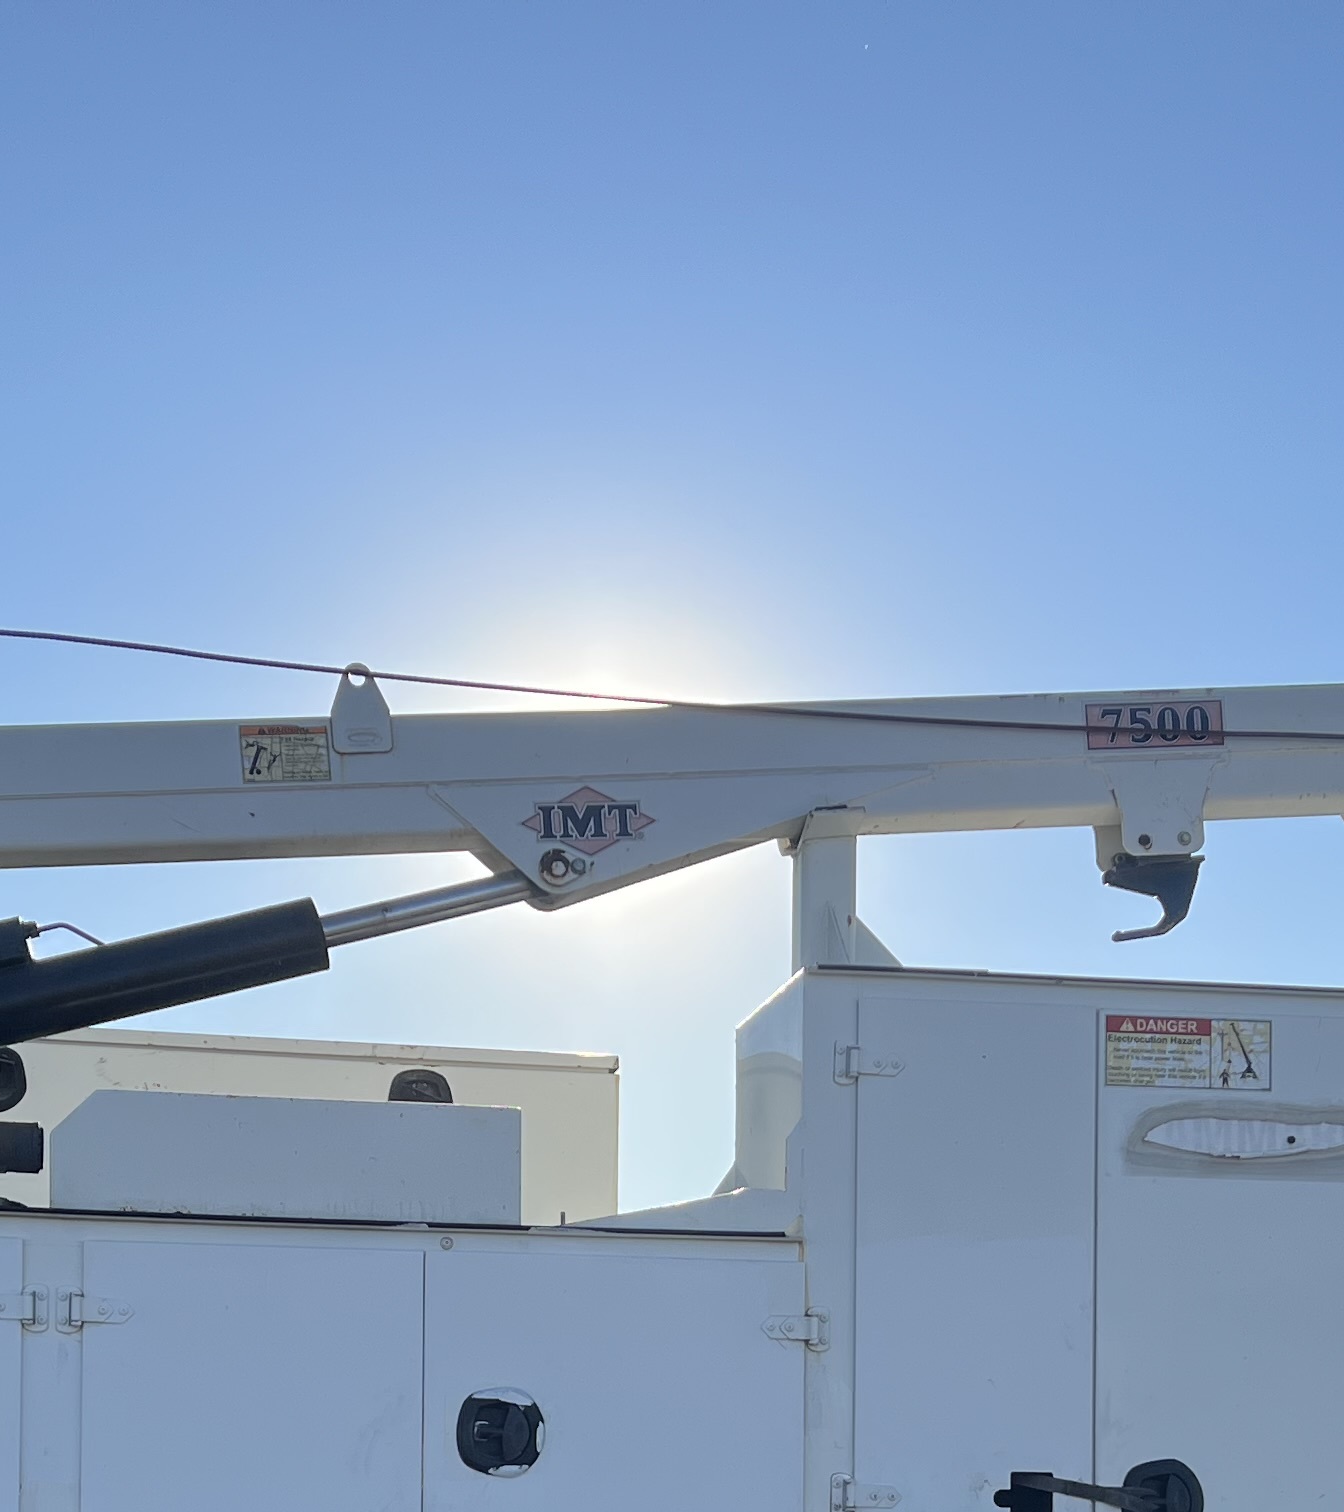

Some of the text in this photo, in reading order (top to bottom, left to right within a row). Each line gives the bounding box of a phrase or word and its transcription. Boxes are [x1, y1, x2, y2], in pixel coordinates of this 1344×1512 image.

[1100, 705, 1210, 743] 7500
[536, 802, 639, 840] IMT
[1136, 1018, 1198, 1033] DANGER
[1170, 1036, 1202, 1046] Hazard
